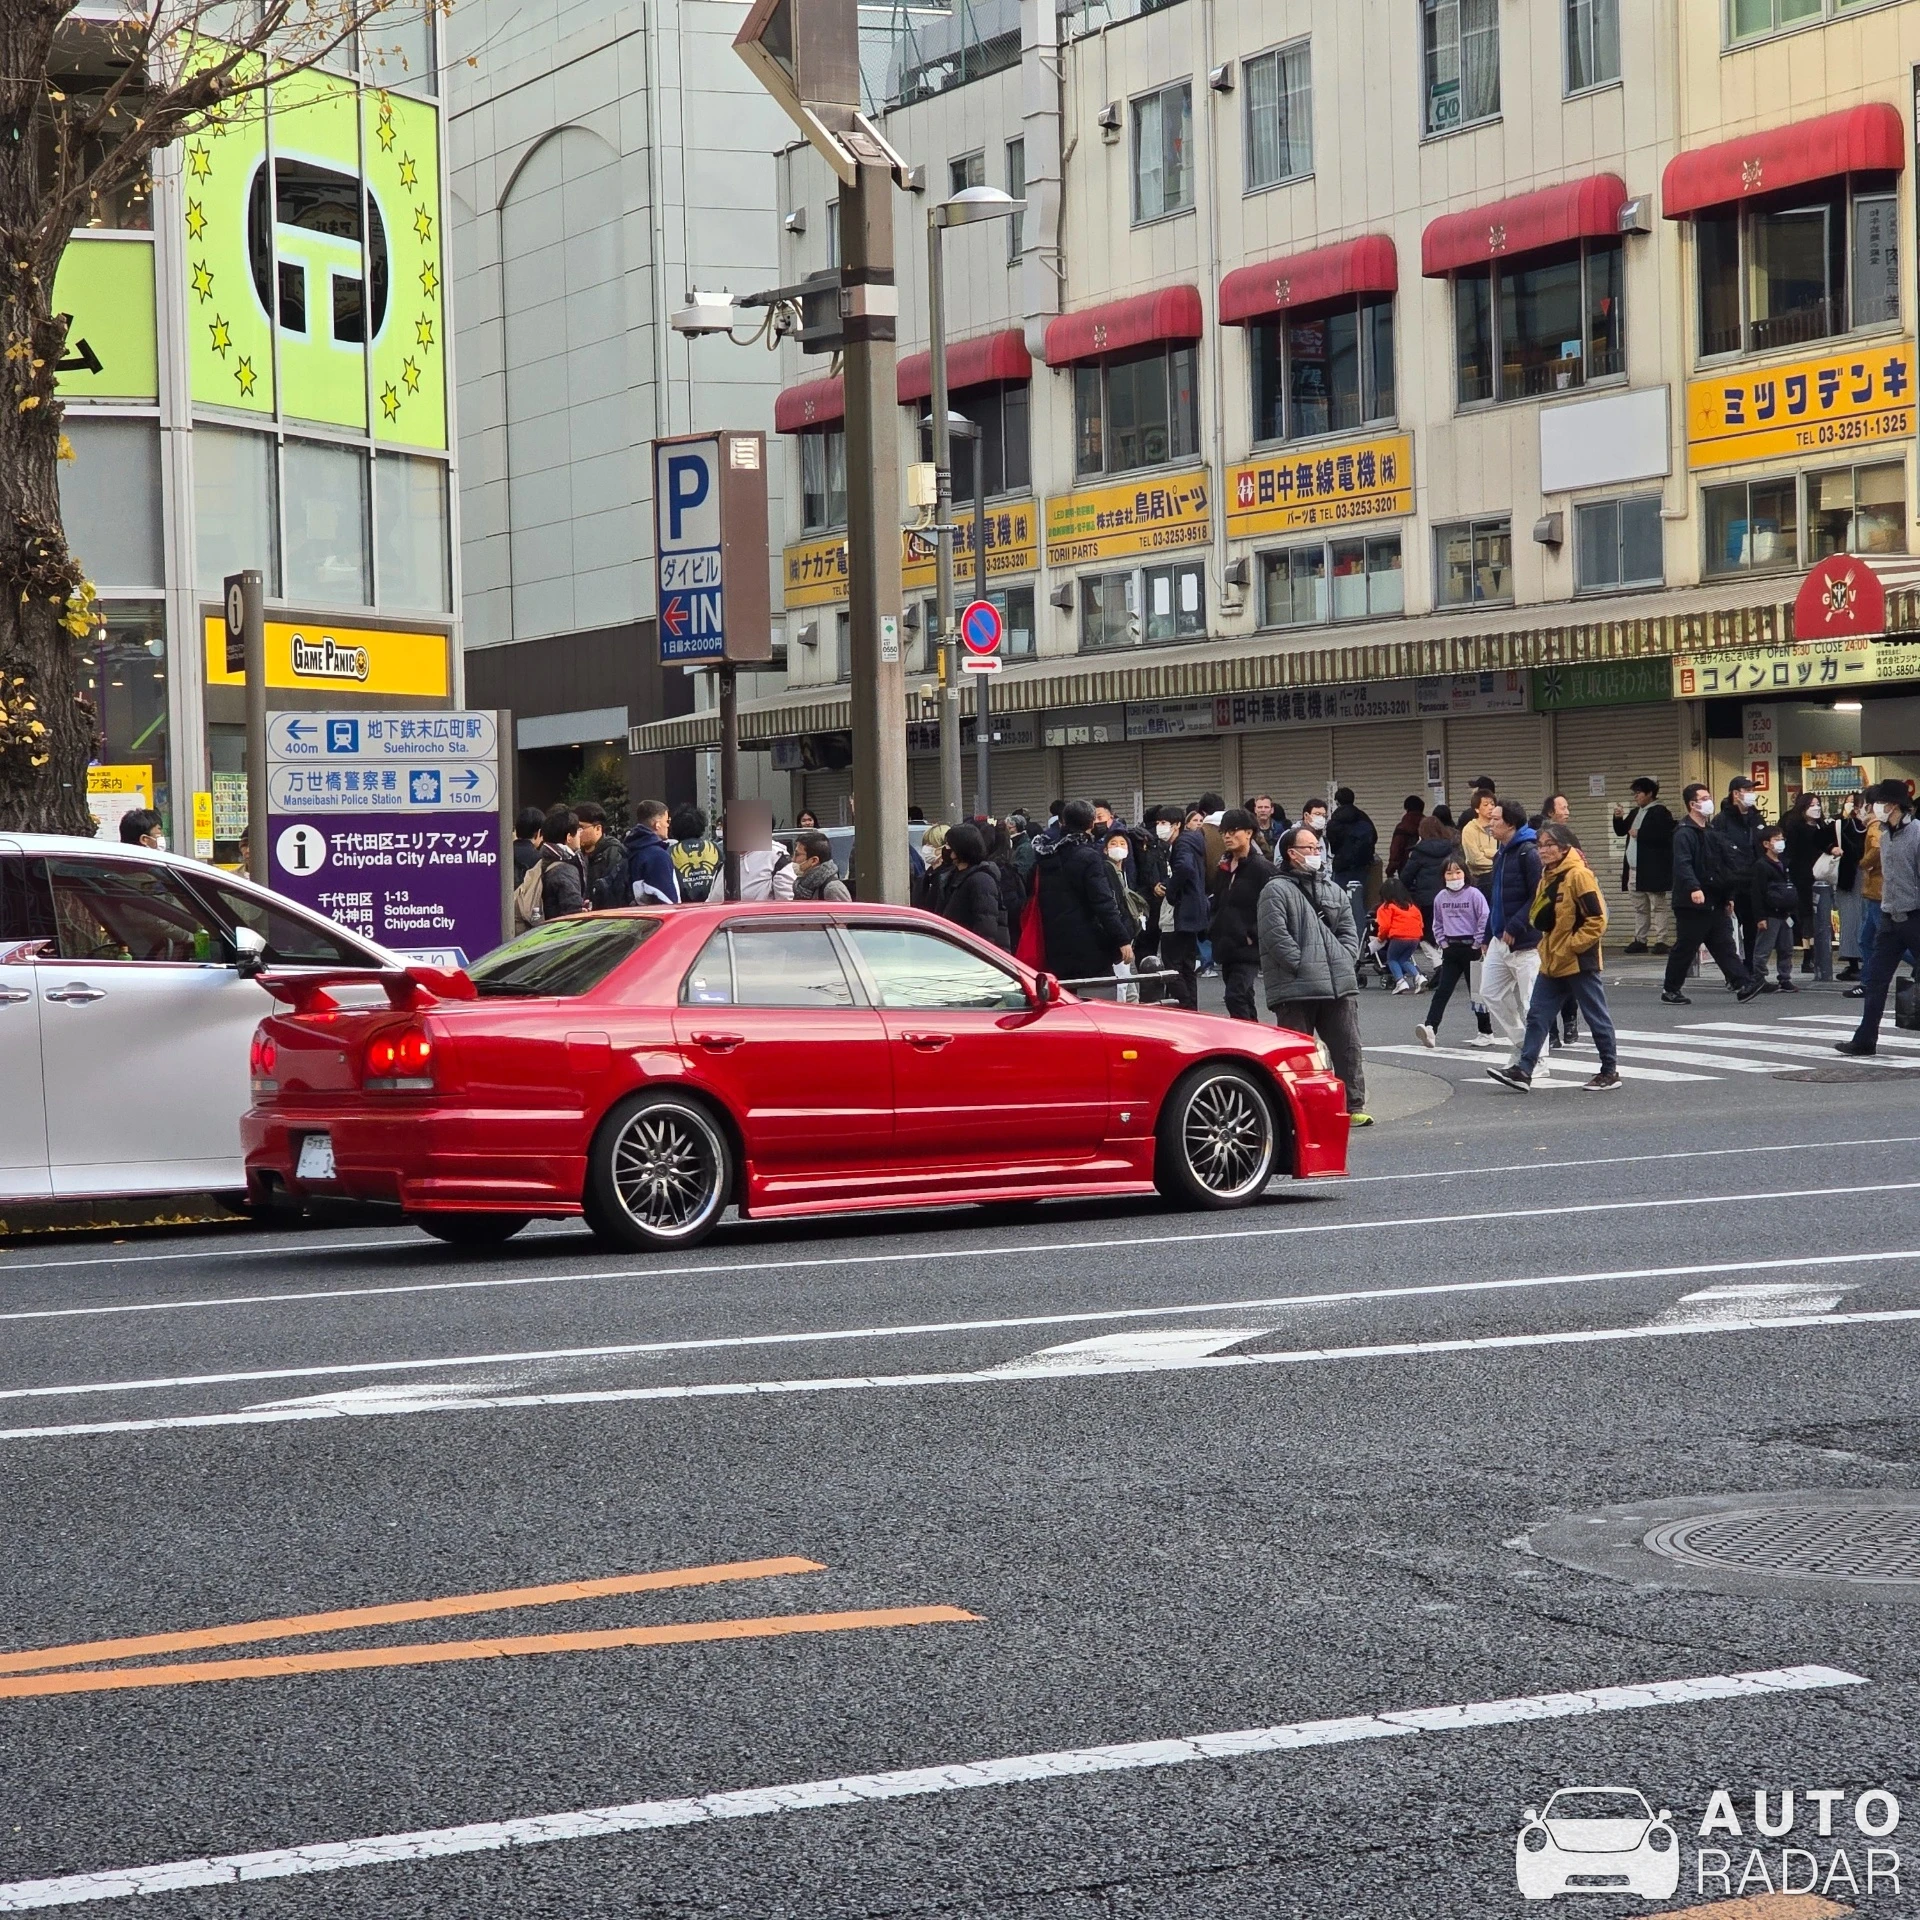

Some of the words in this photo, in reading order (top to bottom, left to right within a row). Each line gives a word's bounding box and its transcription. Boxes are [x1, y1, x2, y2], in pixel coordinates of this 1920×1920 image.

[1796, 432, 1815, 446] TEL
[1819, 414, 1907, 444] 03-3251-1325
[668, 454, 710, 540] P
[1287, 508, 1316, 525] パーツ店
[1320, 509, 1333, 521] TEL
[1336, 496, 1397, 518] 03-3253-3201
[1139, 536, 1151, 548] TEL
[1153, 525, 1208, 546] 03-3253-9518
[1049, 546, 1070, 563] TORII
[1072, 543, 1098, 560] PARTS
[664, 556, 718, 587] ダイビル
[832, 586, 842, 596] TEL
[1822, 592, 1831, 605] G
[1849, 590, 1857, 602] V
[691, 592, 722, 635] IN
[1767, 646, 1790, 659] OPEN
[1792, 645, 1810, 657] 5:30
[1815, 642, 1843, 654] CLOSE
[1845, 639, 1868, 651] 24:00
[1702, 656, 1864, 692] コインロッカー
[1340, 706, 1353, 717] TEL
[1354, 700, 1410, 718] 03-3253-3201
[368, 719, 482, 739] 地下鉄末広町駅
[1752, 718, 1772, 730] 5:30
[285, 743, 318, 754] 400m
[384, 742, 444, 753] Suehirocho
[448, 742, 469, 753] Sta.
[1748, 741, 1772, 754] 24:00
[288, 771, 397, 791] 万世橋警察署
[284, 794, 339, 805] Manseibashi
[341, 794, 368, 804] Police
[372, 794, 402, 804] Station
[450, 793, 481, 803] 150m
[330, 830, 488, 851] 千代田区エリアマップ
[332, 853, 392, 869] Chiyoda
[396, 852, 424, 867] City
[429, 851, 462, 865] Area
[467, 850, 497, 866] Map
[318, 892, 373, 907] 千代田区
[384, 891, 409, 902] 1-13
[331, 909, 373, 923] 外神田
[384, 904, 444, 915] Sotokanda
[344, 925, 374, 939] -13
[384, 918, 430, 931] Chiyoda
[433, 917, 455, 930] City
